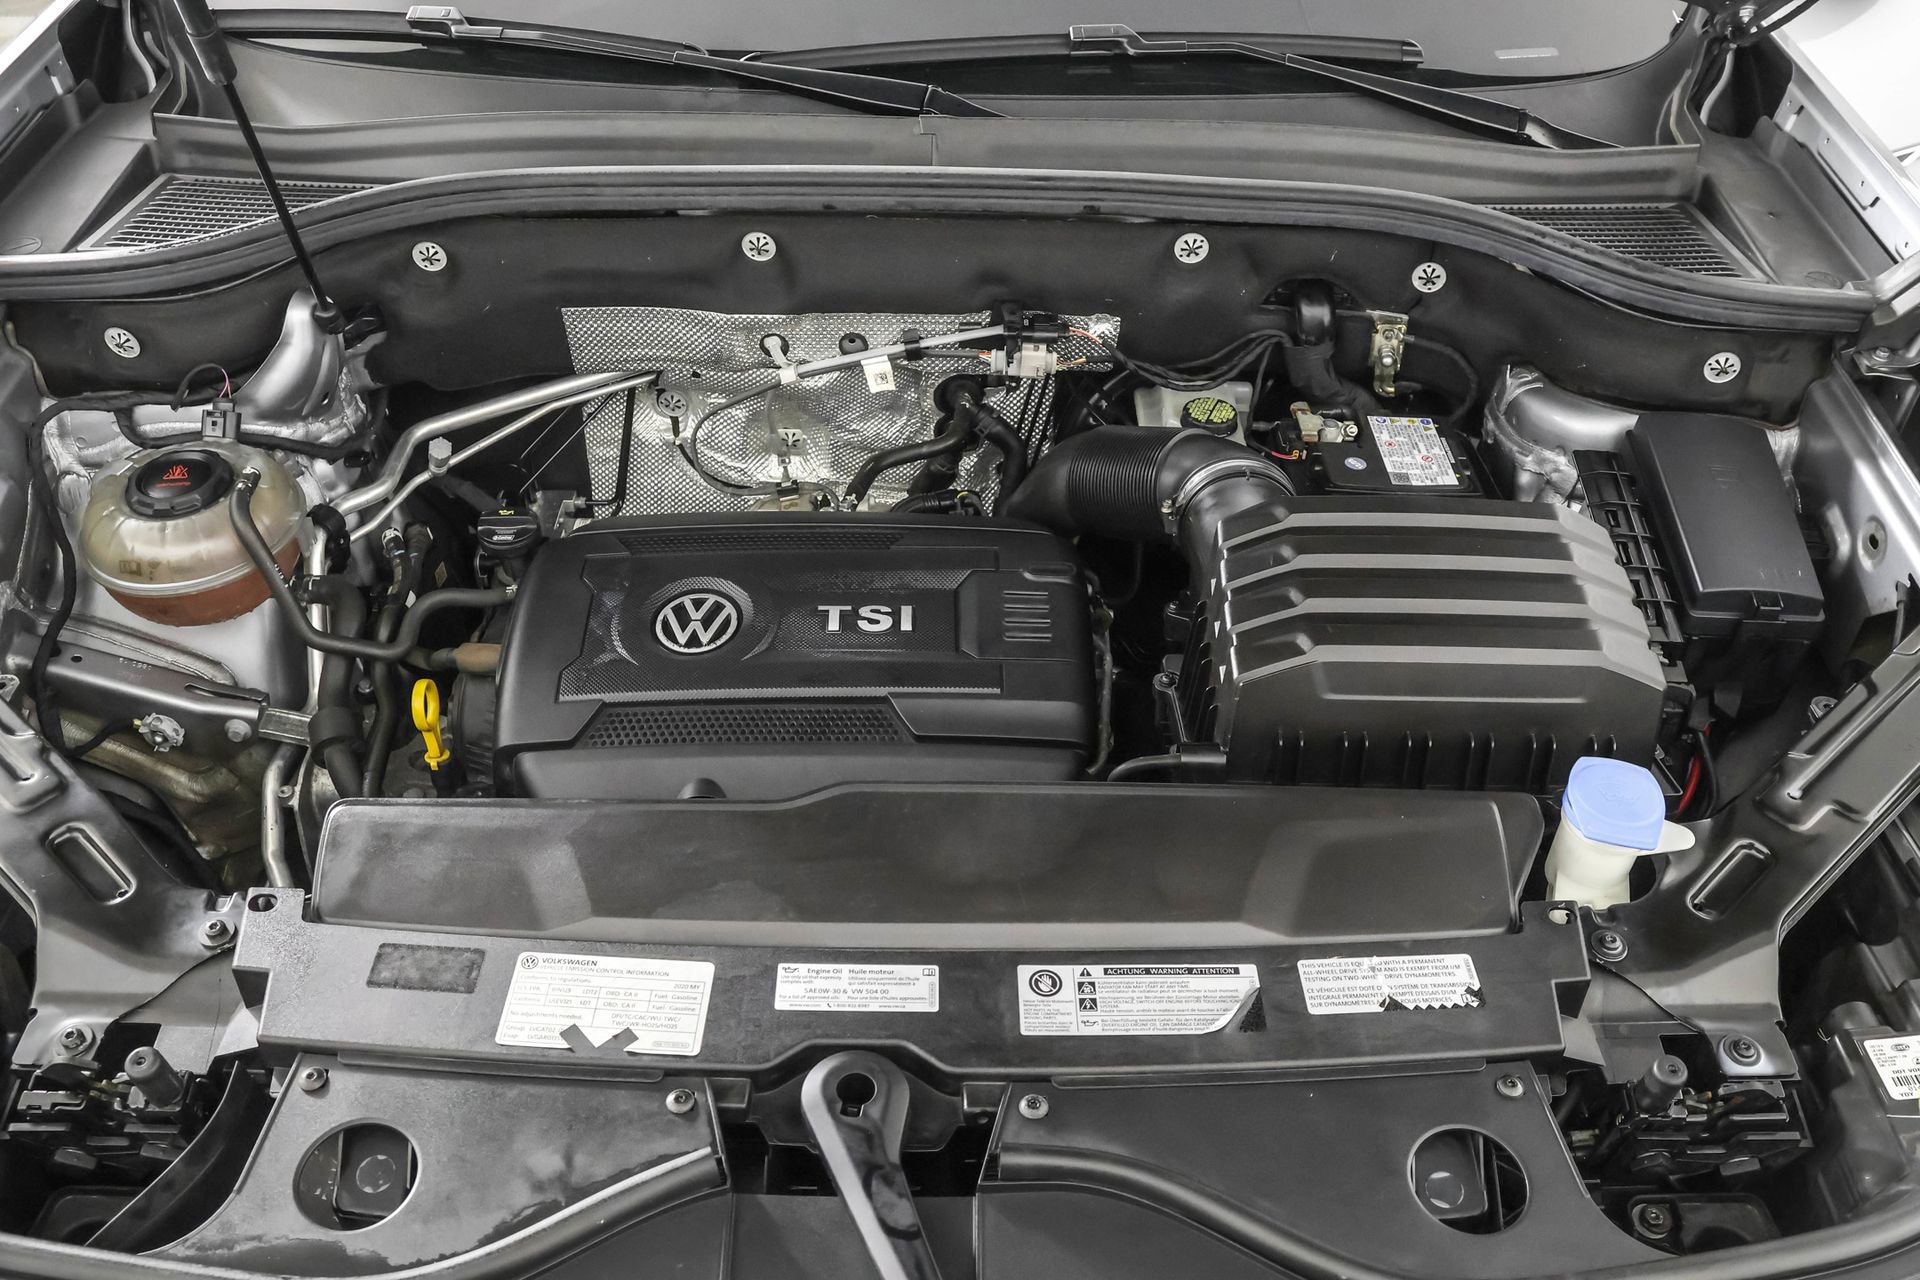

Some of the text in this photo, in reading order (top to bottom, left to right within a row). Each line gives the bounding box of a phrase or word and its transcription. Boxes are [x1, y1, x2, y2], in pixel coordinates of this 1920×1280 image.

[655, 593, 738, 654] VW
[818, 605, 913, 632] TSI
[542, 958, 598, 967] VOLKSWAGEN
